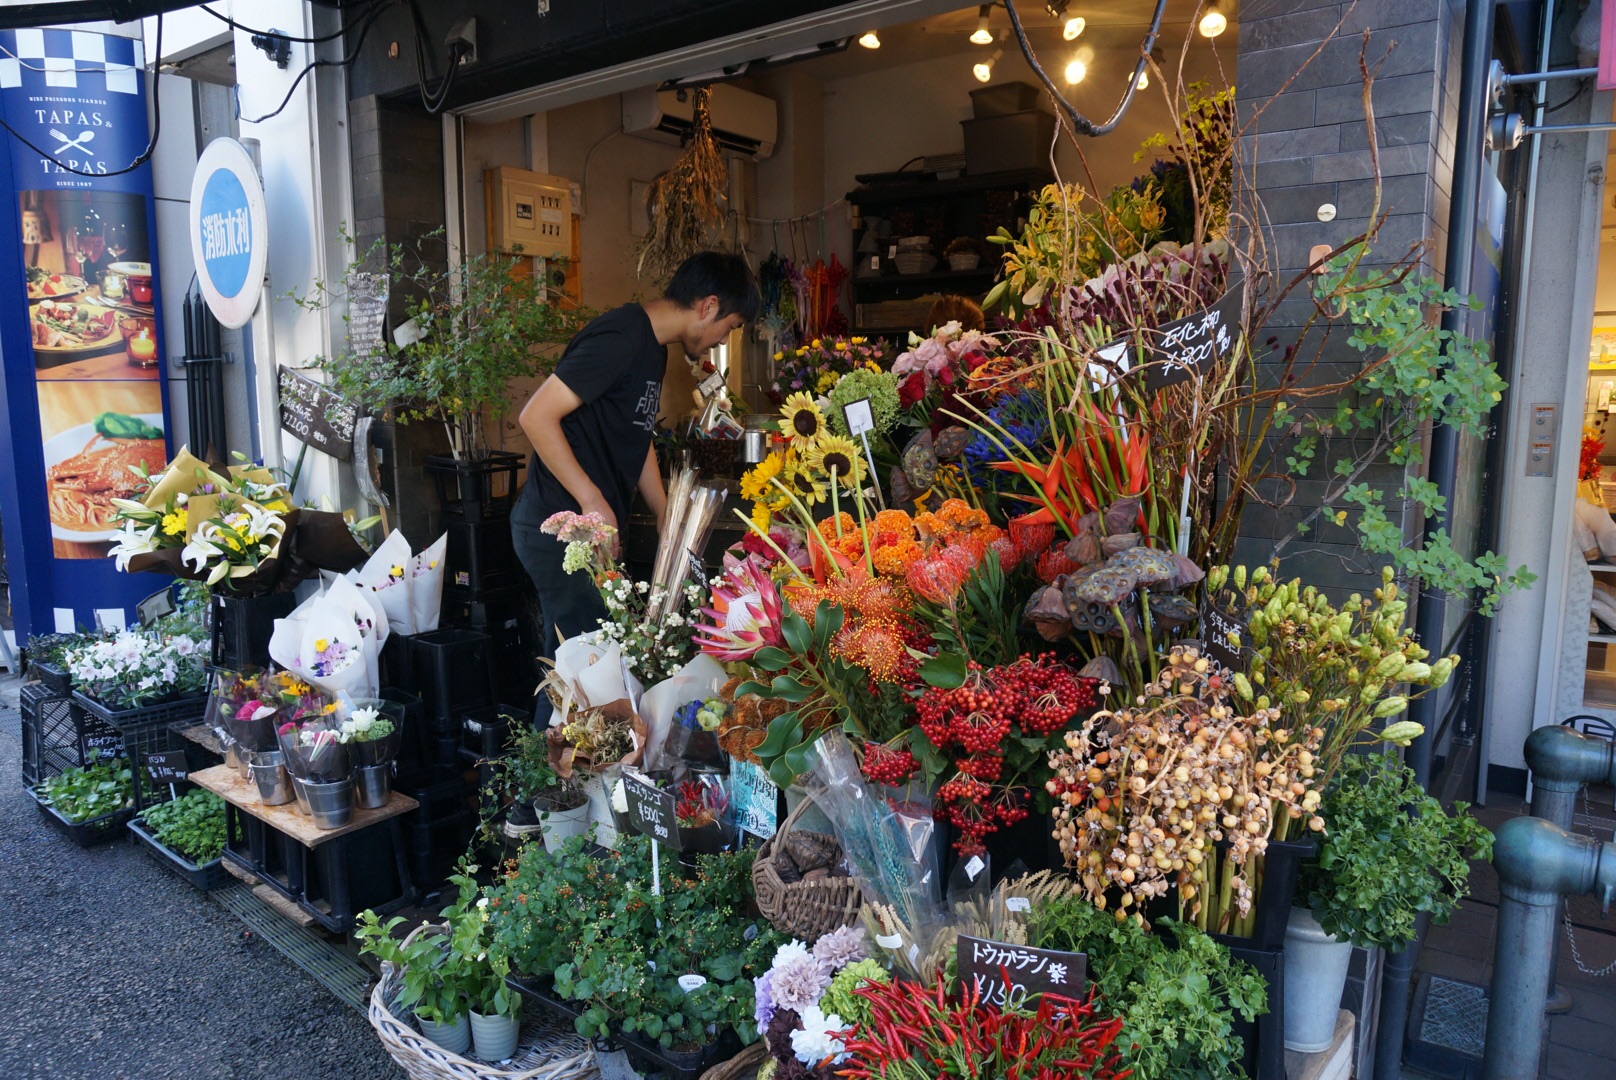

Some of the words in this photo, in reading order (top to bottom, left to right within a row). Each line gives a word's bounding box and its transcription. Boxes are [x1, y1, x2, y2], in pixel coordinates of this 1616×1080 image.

[41, 159, 107, 175] TAPAS
[202, 206, 250, 260] 消防水利
[283, 411, 309, 436] ¥1100
